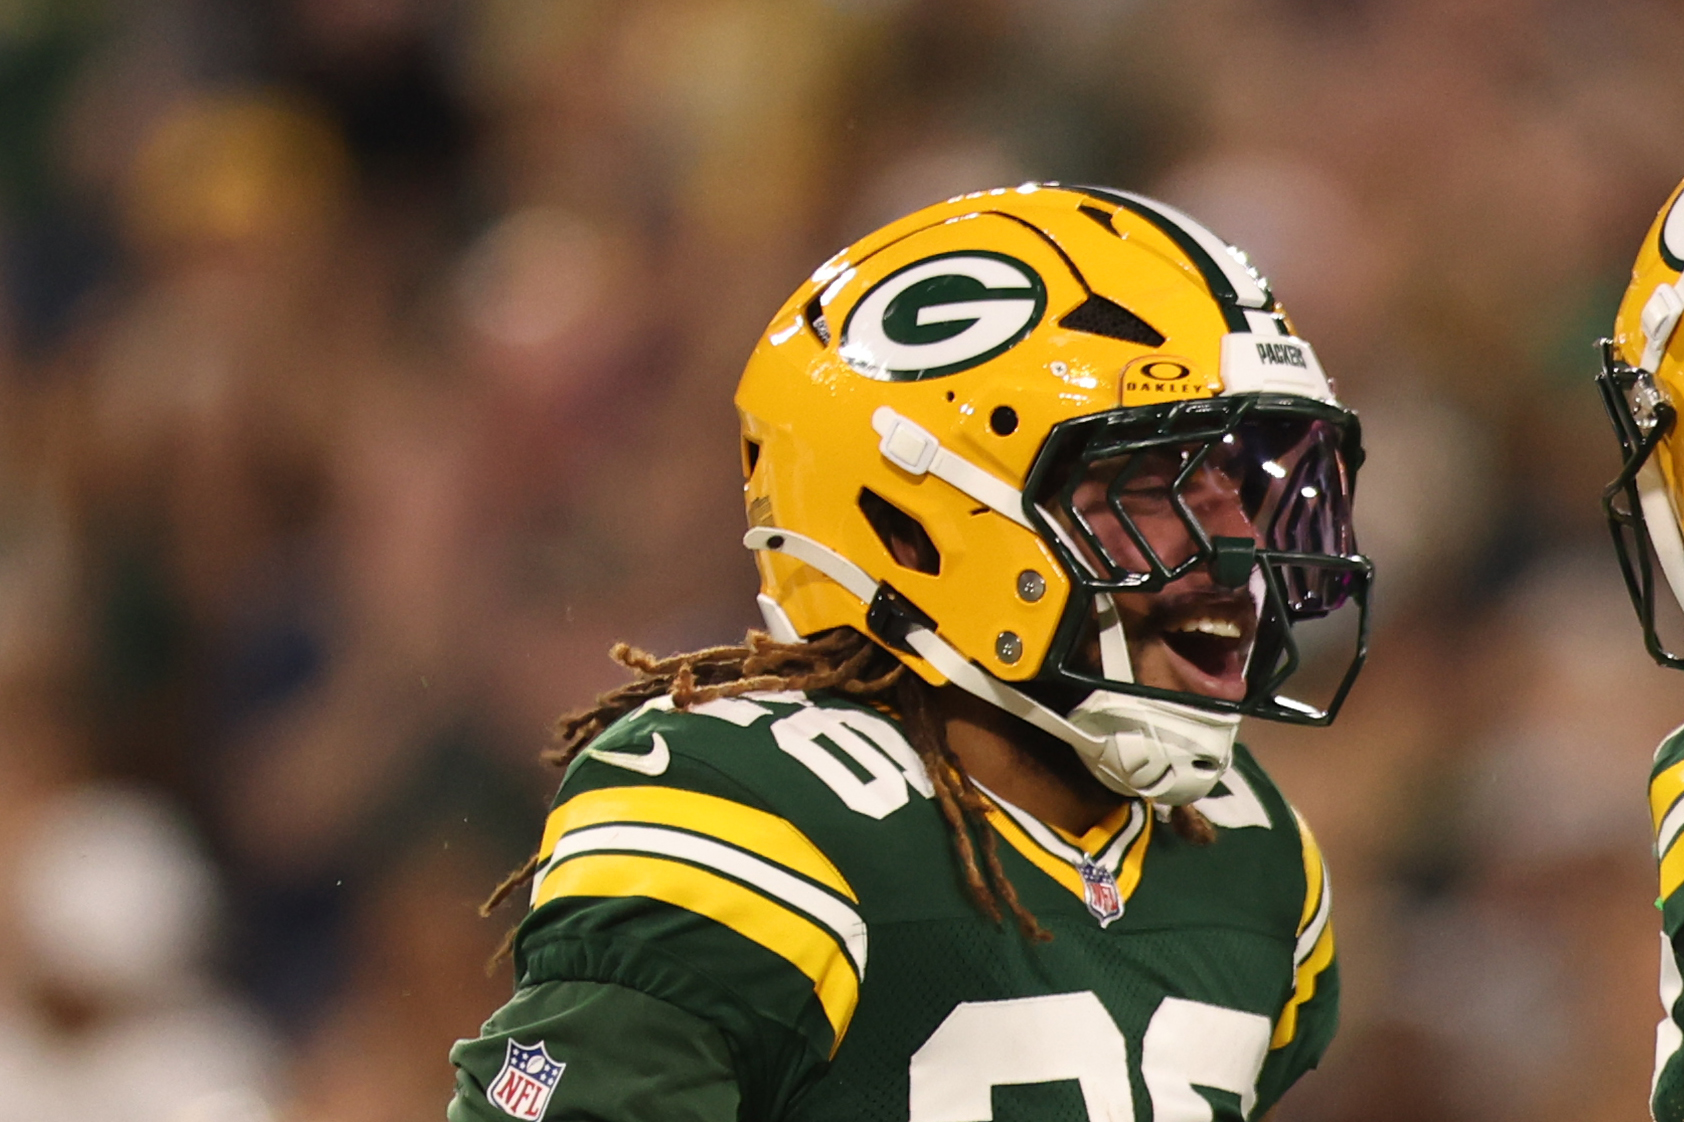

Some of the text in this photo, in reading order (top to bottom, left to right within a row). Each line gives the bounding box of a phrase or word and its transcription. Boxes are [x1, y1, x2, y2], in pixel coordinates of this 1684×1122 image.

[839, 255, 1040, 378] G
[1126, 382, 1202, 393] OAKLEY
[497, 1069, 543, 1117] NFL
